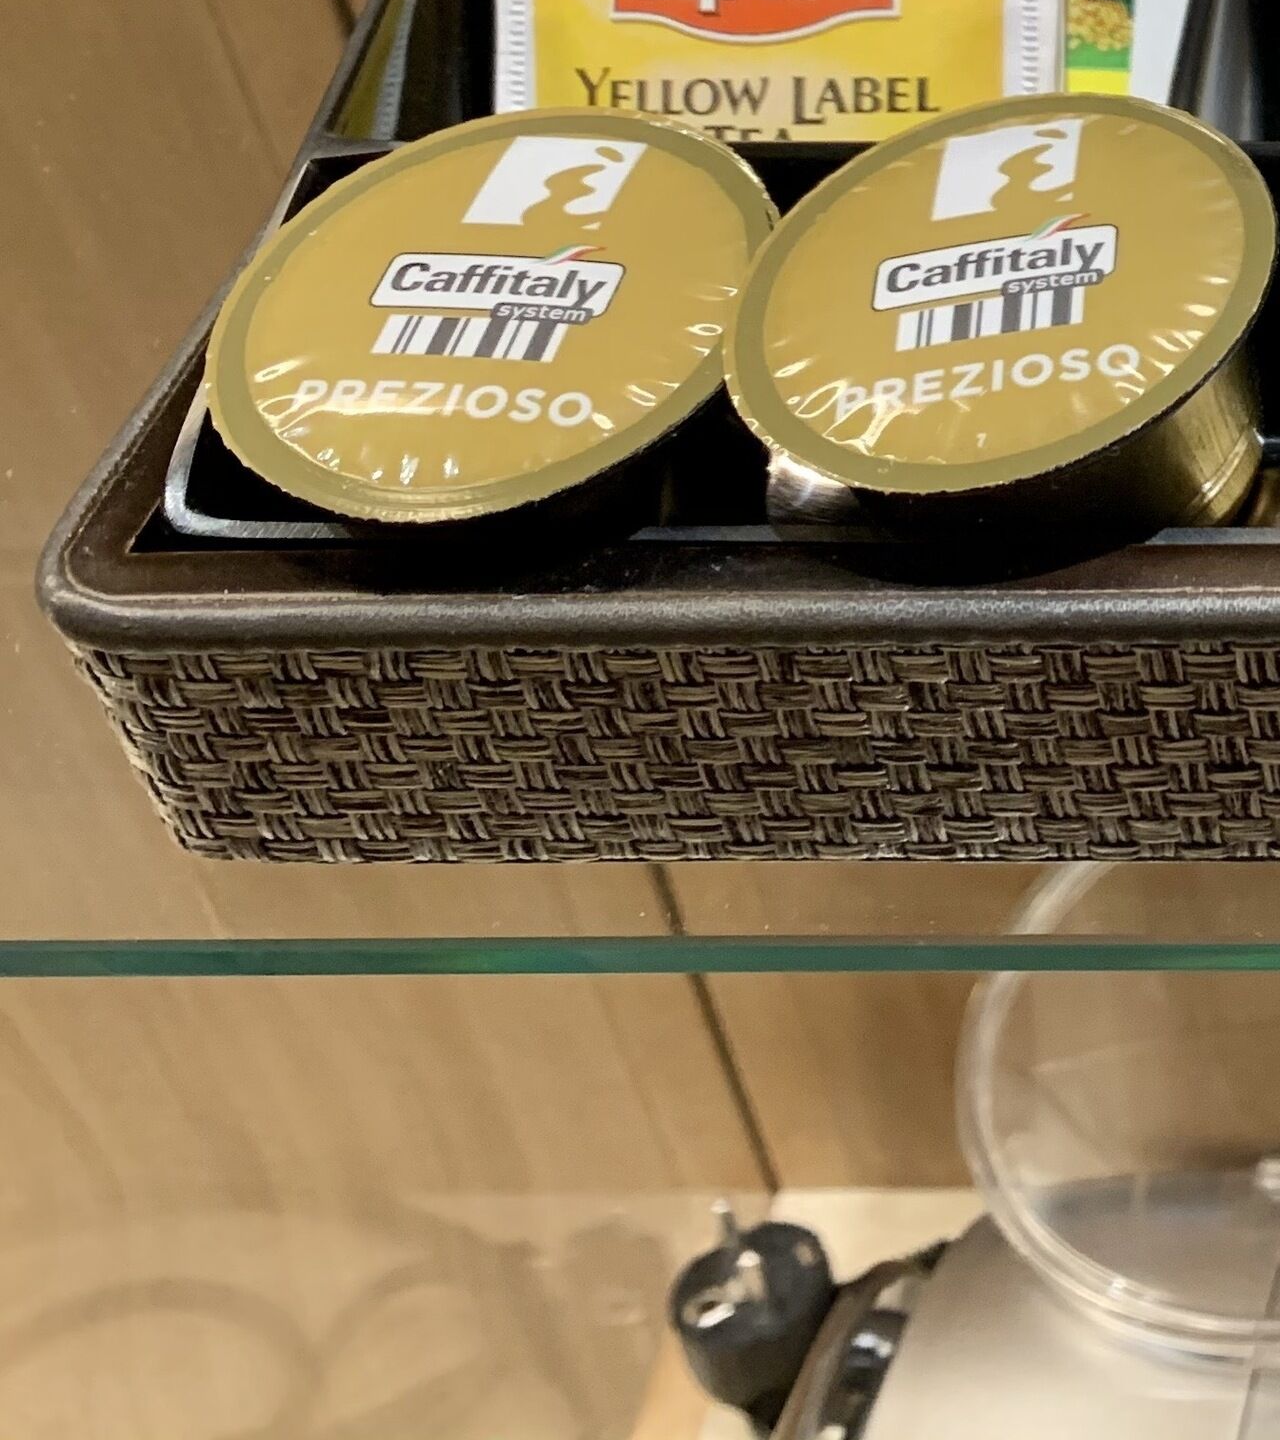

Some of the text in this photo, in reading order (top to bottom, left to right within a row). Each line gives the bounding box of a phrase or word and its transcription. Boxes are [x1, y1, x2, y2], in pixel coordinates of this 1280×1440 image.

[575, 67, 940, 124] YELLOW LABEL
[391, 262, 607, 308] Caffitaly
[886, 238, 1106, 294] Caffitaly
[1007, 271, 1099, 294] system
[496, 303, 587, 322] system
[289, 379, 593, 427] PREZIOSO
[834, 344, 1140, 423] PREZIOSO
